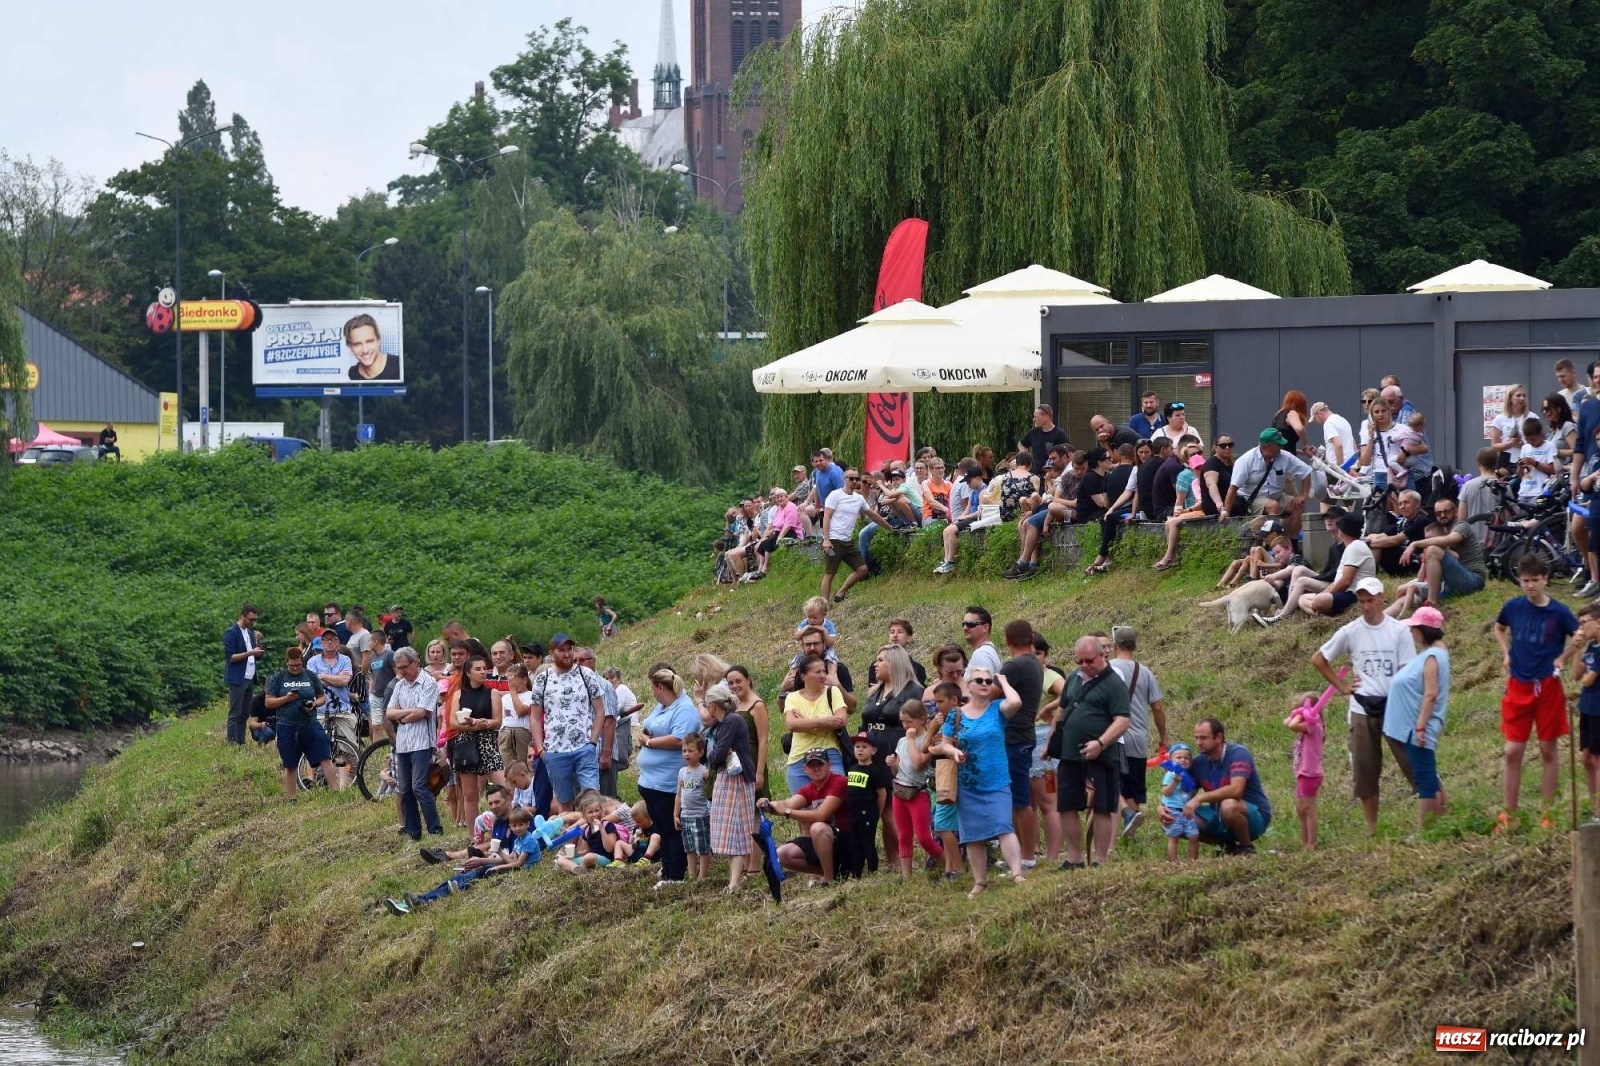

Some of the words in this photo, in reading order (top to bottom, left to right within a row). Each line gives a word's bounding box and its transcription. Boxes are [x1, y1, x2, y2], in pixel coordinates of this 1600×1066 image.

[266, 321, 313, 334] OSTATNIA
[266, 327, 342, 347] PROSTA!
[825, 369, 868, 382] OKOCIM
[938, 368, 987, 381] OKOCIM
